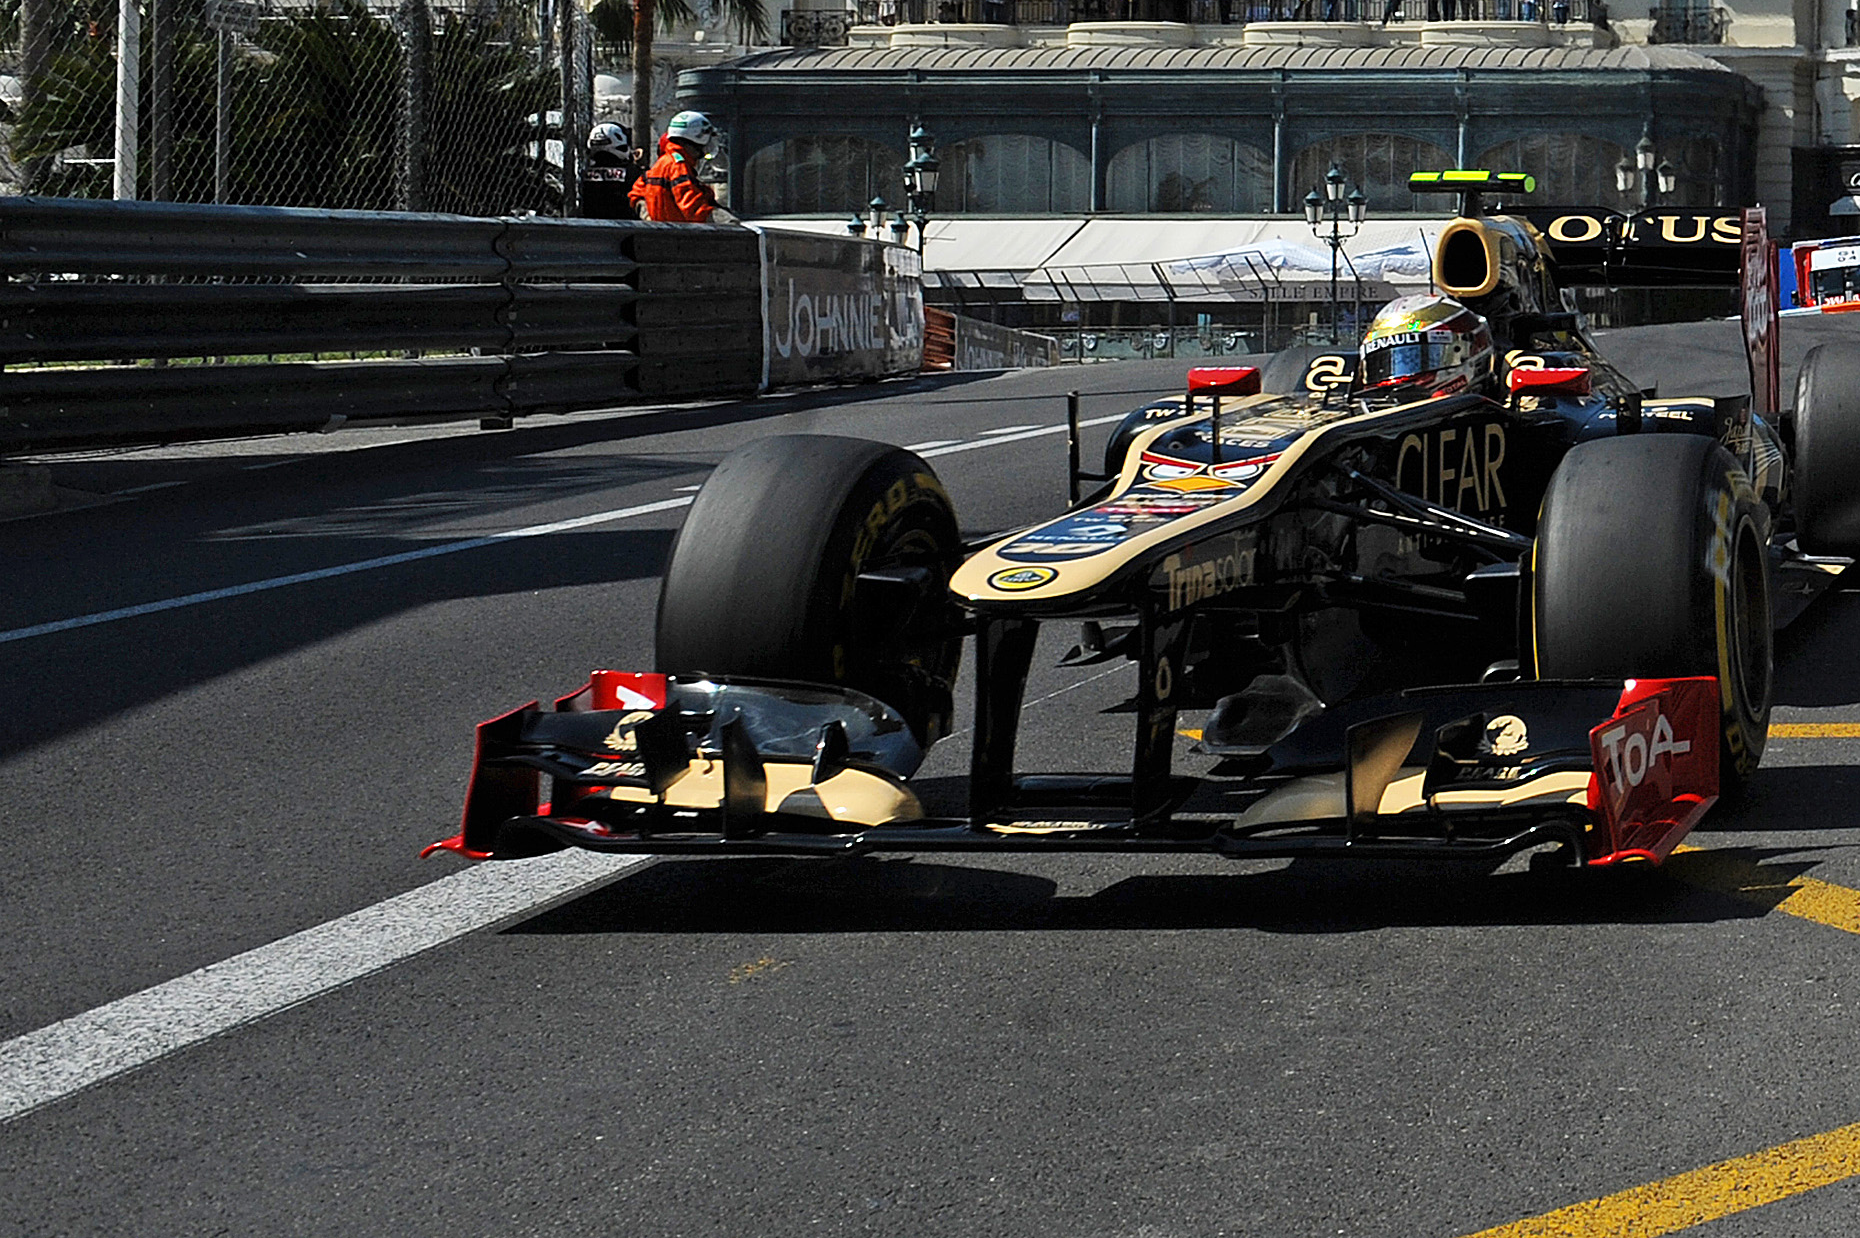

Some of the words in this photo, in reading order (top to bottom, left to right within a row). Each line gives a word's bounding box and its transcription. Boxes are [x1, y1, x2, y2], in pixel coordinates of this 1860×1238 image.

[1540, 215, 1741, 244] OTUS
[775, 277, 885, 358] JOHNNIE
[1365, 332, 1421, 354] RENAULT
[1396, 423, 1507, 512] CLEAR
